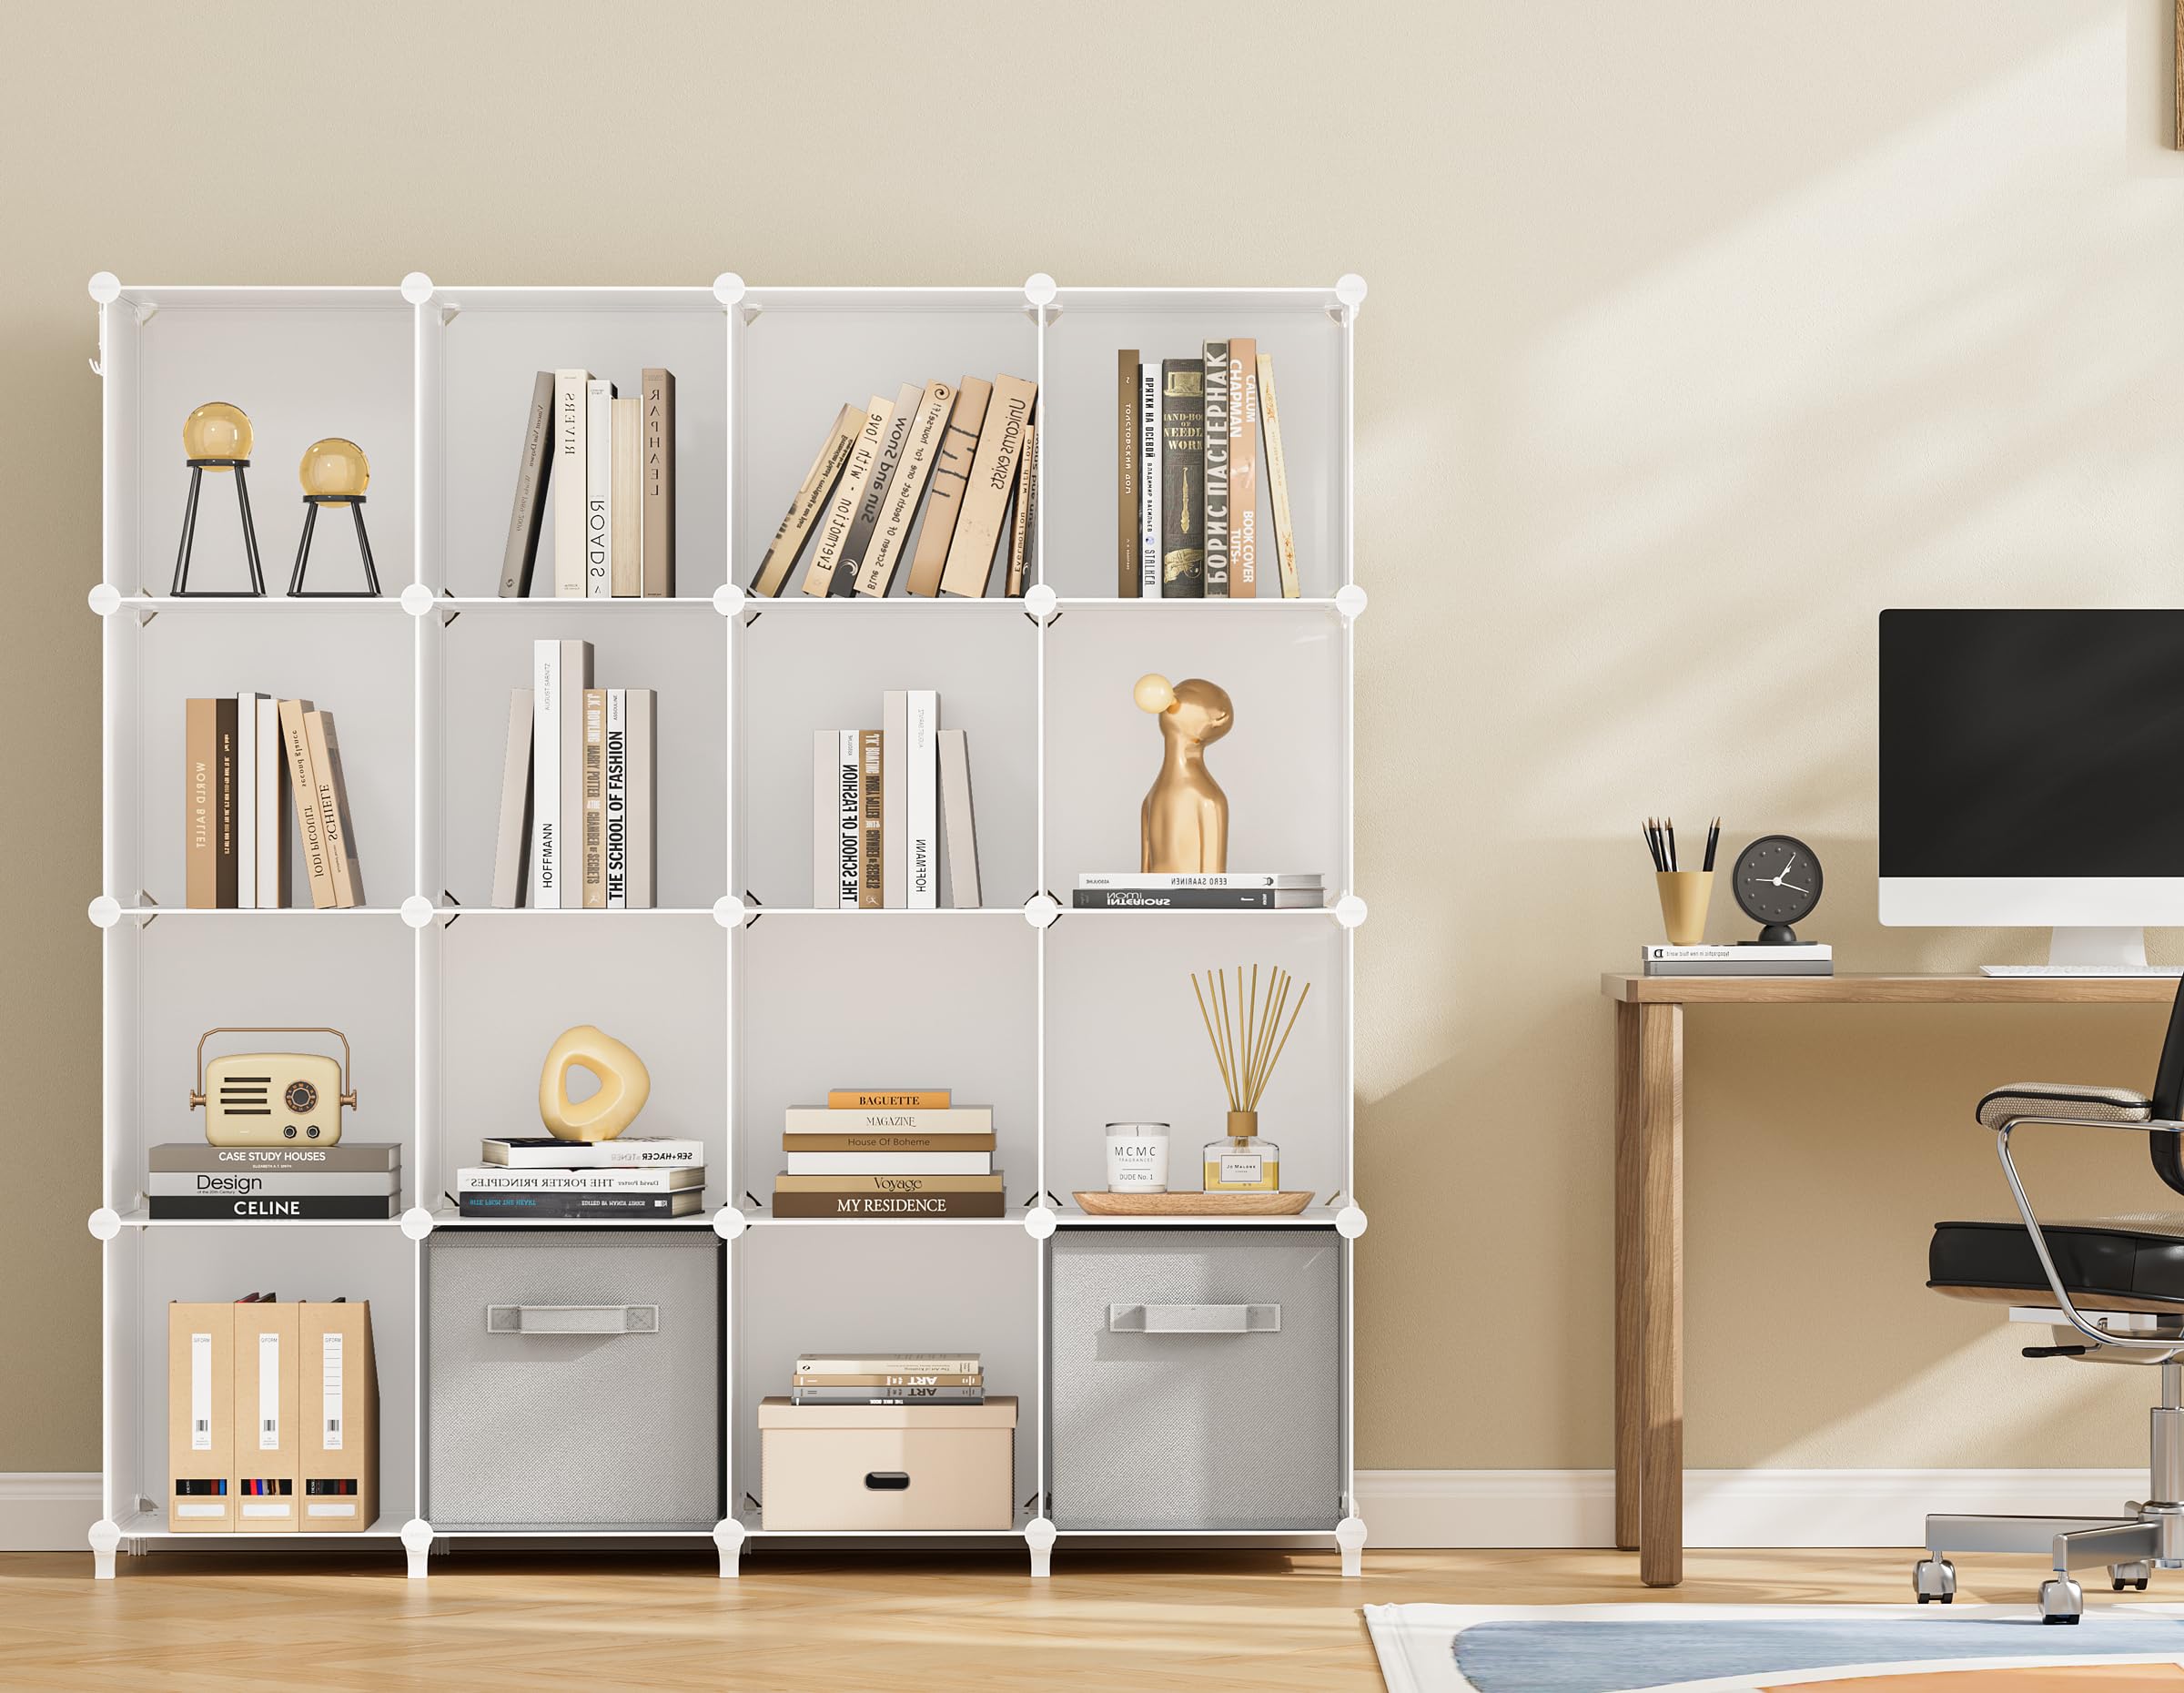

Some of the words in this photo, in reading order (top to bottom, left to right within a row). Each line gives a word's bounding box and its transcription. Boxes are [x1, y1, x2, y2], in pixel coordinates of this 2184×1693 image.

[1145, 377, 1155, 409] ПРЯТКИ
[1229, 358, 1243, 439] CHAPMAN
[1245, 373, 1256, 422] CALLUM
[1145, 411, 1155, 423] НА
[1206, 350, 1228, 496] ПАСТЕРНАК
[1145, 426, 1156, 458] ОСЕВОЙ
[1014, 512, 1025, 573] Evermotion
[1024, 439, 1032, 461] love
[1242, 510, 1255, 542] BOOK
[1207, 504, 1228, 584] БОРИС
[1230, 528, 1241, 565] TUTS+
[1242, 544, 1255, 583] COVER
[586, 709, 601, 743] ROWLING
[586, 745, 601, 769] HARRY
[609, 731, 623, 789] FASHION
[586, 770, 601, 798] POTTER
[609, 793, 623, 812] OF
[586, 811, 600, 846] CHAMBER
[609, 815, 623, 870] SCHOOL
[542, 822, 552, 888] HOFFMANN
[586, 852, 600, 885] SECRETS
[609, 871, 623, 901] THE
[859, 1096, 920, 1106] BAGUETTE
[865, 1116, 917, 1128] MAGAZINE
[218, 1151, 246, 1161] CASE
[248, 1151, 283, 1161] STUDY
[284, 1151, 327, 1161] HOUSES
[847, 1138, 876, 1147] House
[878, 1138, 891, 1147] Of
[893, 1138, 931, 1147] Boheme
[1115, 1146, 1157, 1157] MCMC
[197, 1174, 262, 1195] Design
[874, 1176, 923, 1192] Voyage
[233, 1201, 300, 1215] CELINE
[836, 1199, 861, 1212] MY
[864, 1199, 947, 1212] RESIDENCE
[907, 1376, 937, 1385] ART
[907, 1388, 937, 1396] ART
